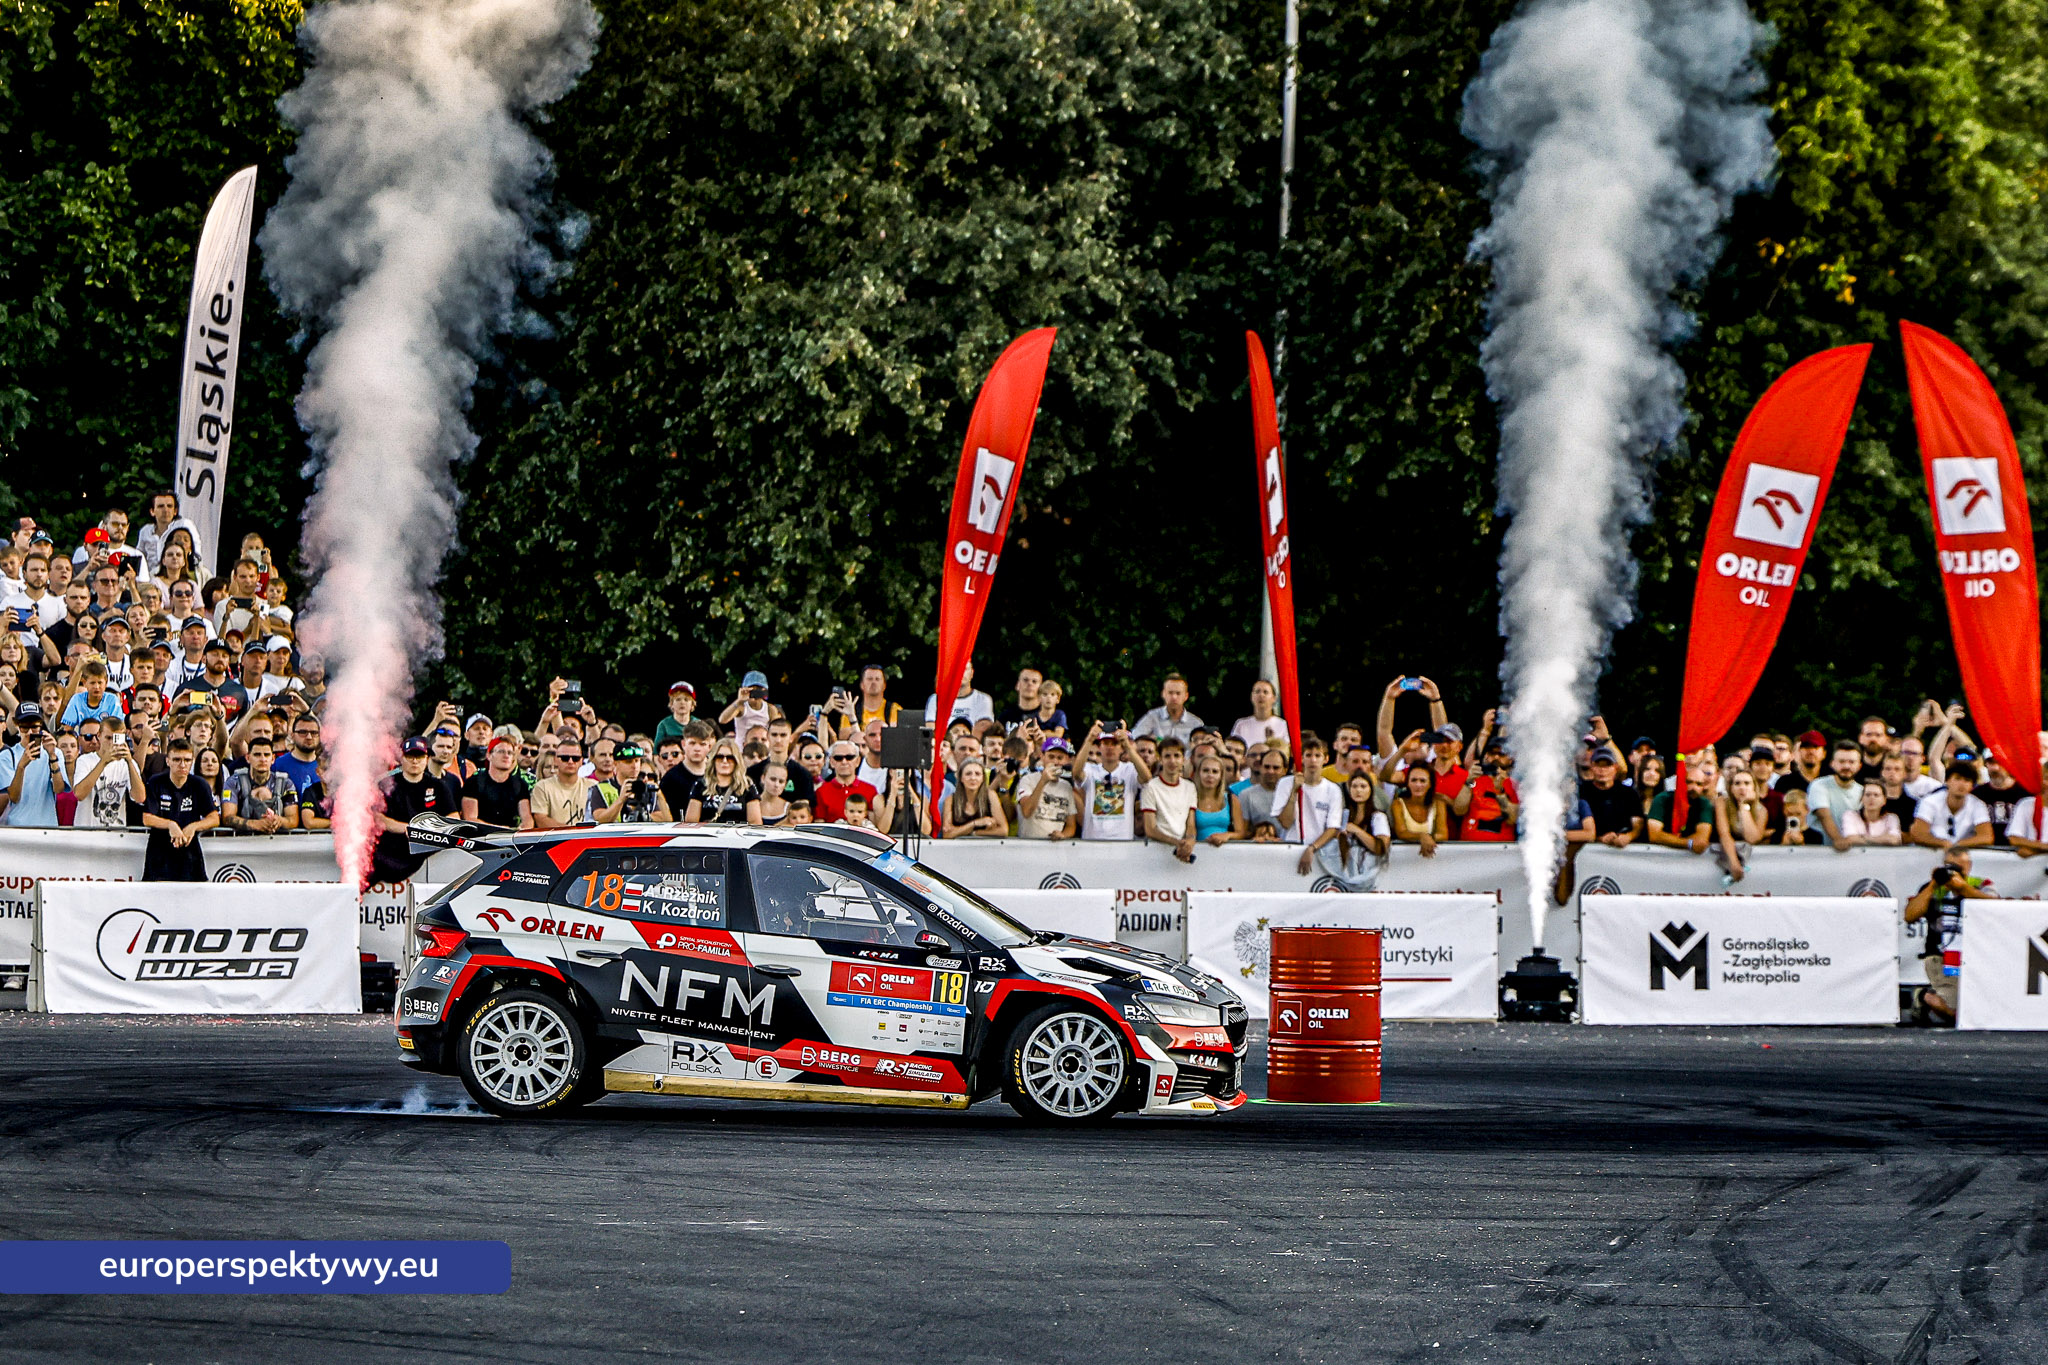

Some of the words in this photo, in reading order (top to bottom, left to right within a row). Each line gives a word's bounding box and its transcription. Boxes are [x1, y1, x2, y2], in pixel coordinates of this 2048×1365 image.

[180, 280, 235, 504] Śląskie.
[582, 870, 624, 911] 18
[642, 900, 657, 914] K.
[661, 901, 720, 921] Kozdroń
[521, 916, 604, 942] ORLEN
[144, 928, 309, 954] MOTO
[1722, 937, 1809, 953] Górnośląsko
[677, 941, 731, 957] PRO-FAMILIA
[979, 956, 1007, 967] RX
[140, 961, 294, 978] WIZJA
[1723, 970, 1801, 985] Metropolia
[619, 959, 777, 1026] NFM
[880, 983, 893, 991] OIL
[880, 973, 915, 985] ORLEN
[939, 972, 963, 1004] 18
[413, 999, 439, 1013] BERG
[861, 997, 872, 1005] FIA
[874, 999, 886, 1007] ERC
[887, 999, 933, 1012] Championship
[1123, 1004, 1150, 1016] RX
[1308, 1007, 1349, 1019] ORLEN
[611, 1007, 657, 1020] NIVETTE
[660, 1015, 694, 1027] FLEET
[698, 1021, 776, 1040] MANAGEMENT
[1308, 1020, 1324, 1029] OIL
[1203, 1032, 1224, 1041] BERG
[672, 1040, 723, 1066] RX
[819, 1050, 861, 1065] BERG
[671, 1061, 722, 1075] POLSKA
[818, 1062, 859, 1073] INWESTYCJE
